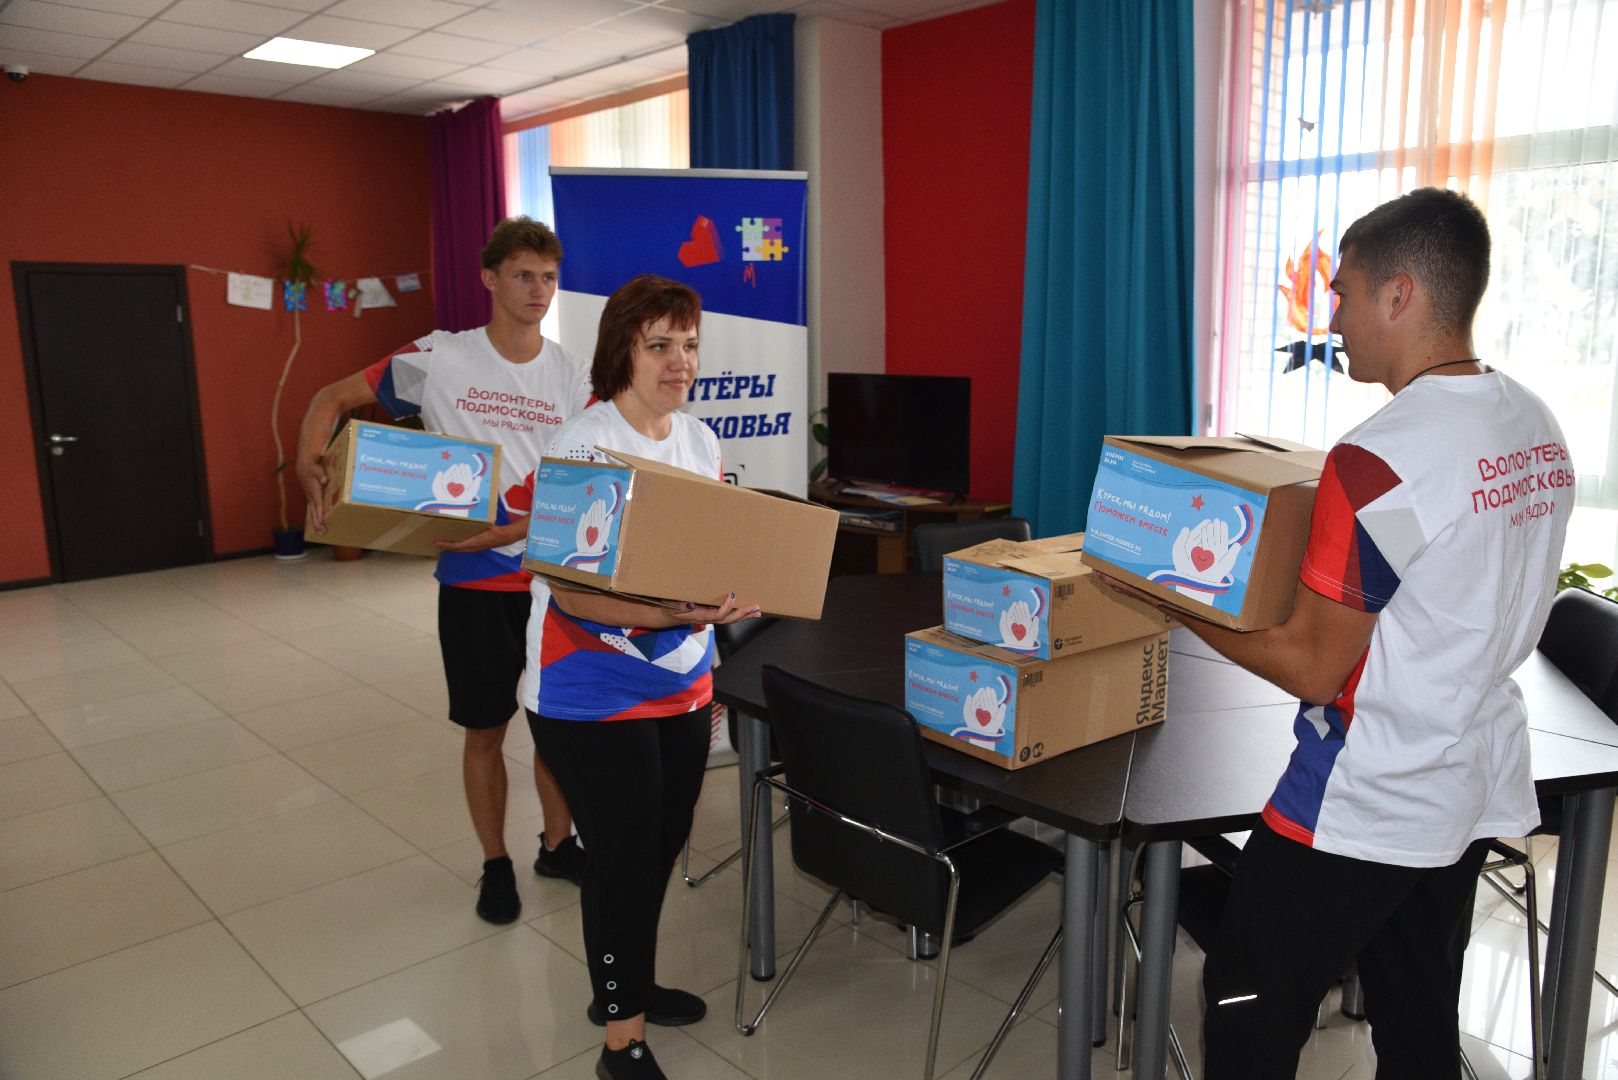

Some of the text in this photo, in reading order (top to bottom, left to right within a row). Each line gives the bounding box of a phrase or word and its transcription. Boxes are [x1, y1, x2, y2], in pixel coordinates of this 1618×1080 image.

[455, 398, 563, 426] ПОДМОСКОВЬЯ
[467, 387, 556, 413] ВОЛОНТЕРЫ
[698, 411, 792, 440] КОВЬЯ
[1136, 643, 1154, 725] Яндекс
[1151, 638, 1168, 720] Маркет
